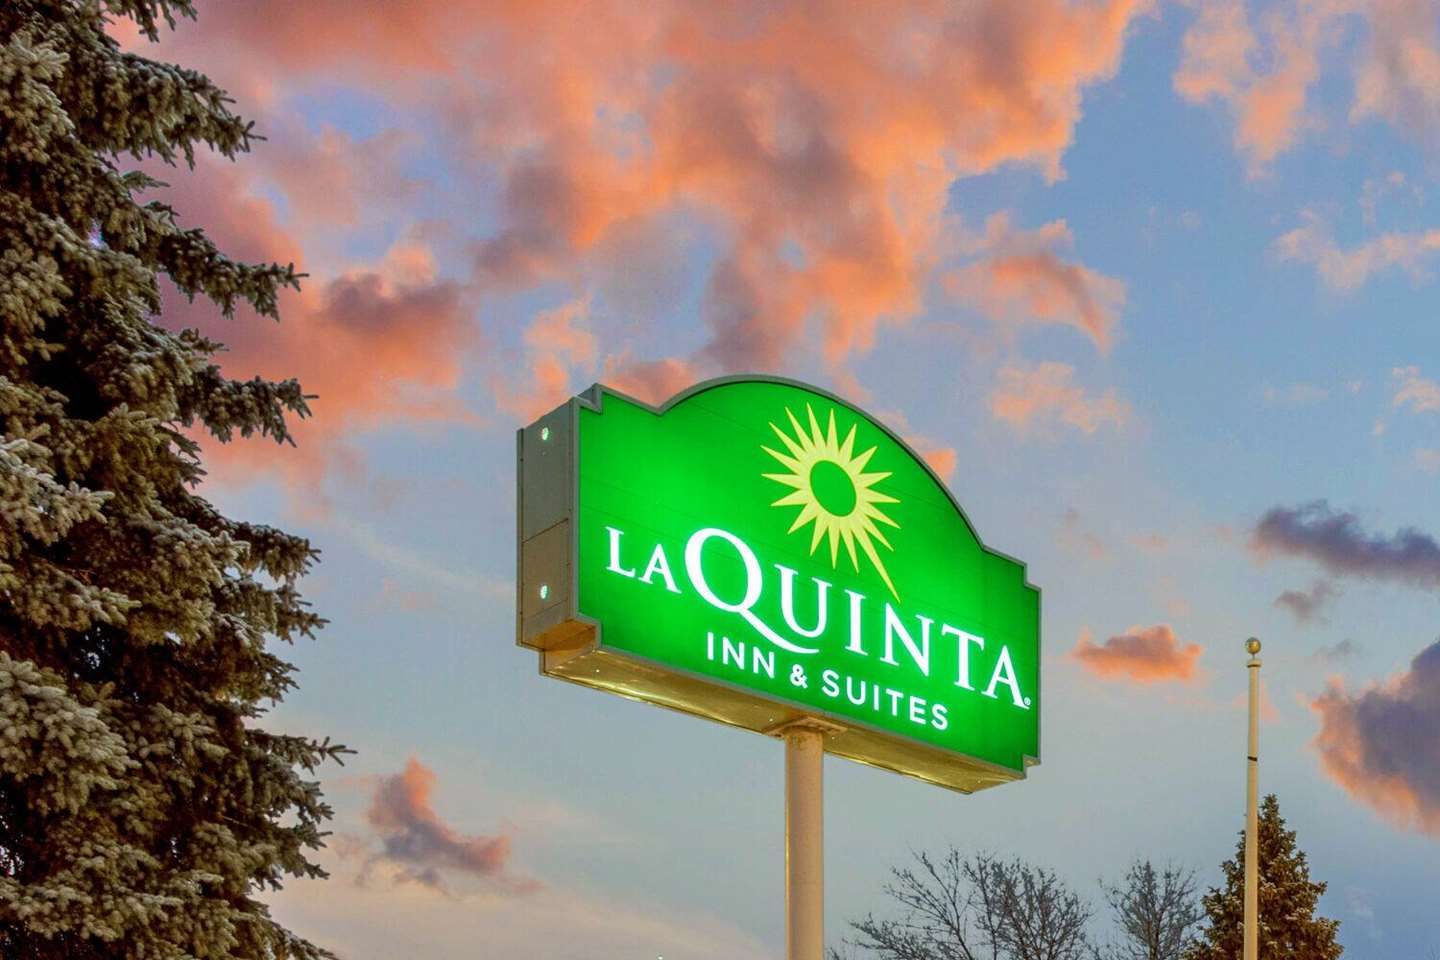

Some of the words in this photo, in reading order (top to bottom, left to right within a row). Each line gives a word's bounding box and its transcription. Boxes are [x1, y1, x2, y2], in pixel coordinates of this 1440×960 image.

[605, 525, 682, 594] LA
[706, 631, 776, 679] INN
[790, 663, 809, 690] &
[821, 669, 949, 731] SUITES
